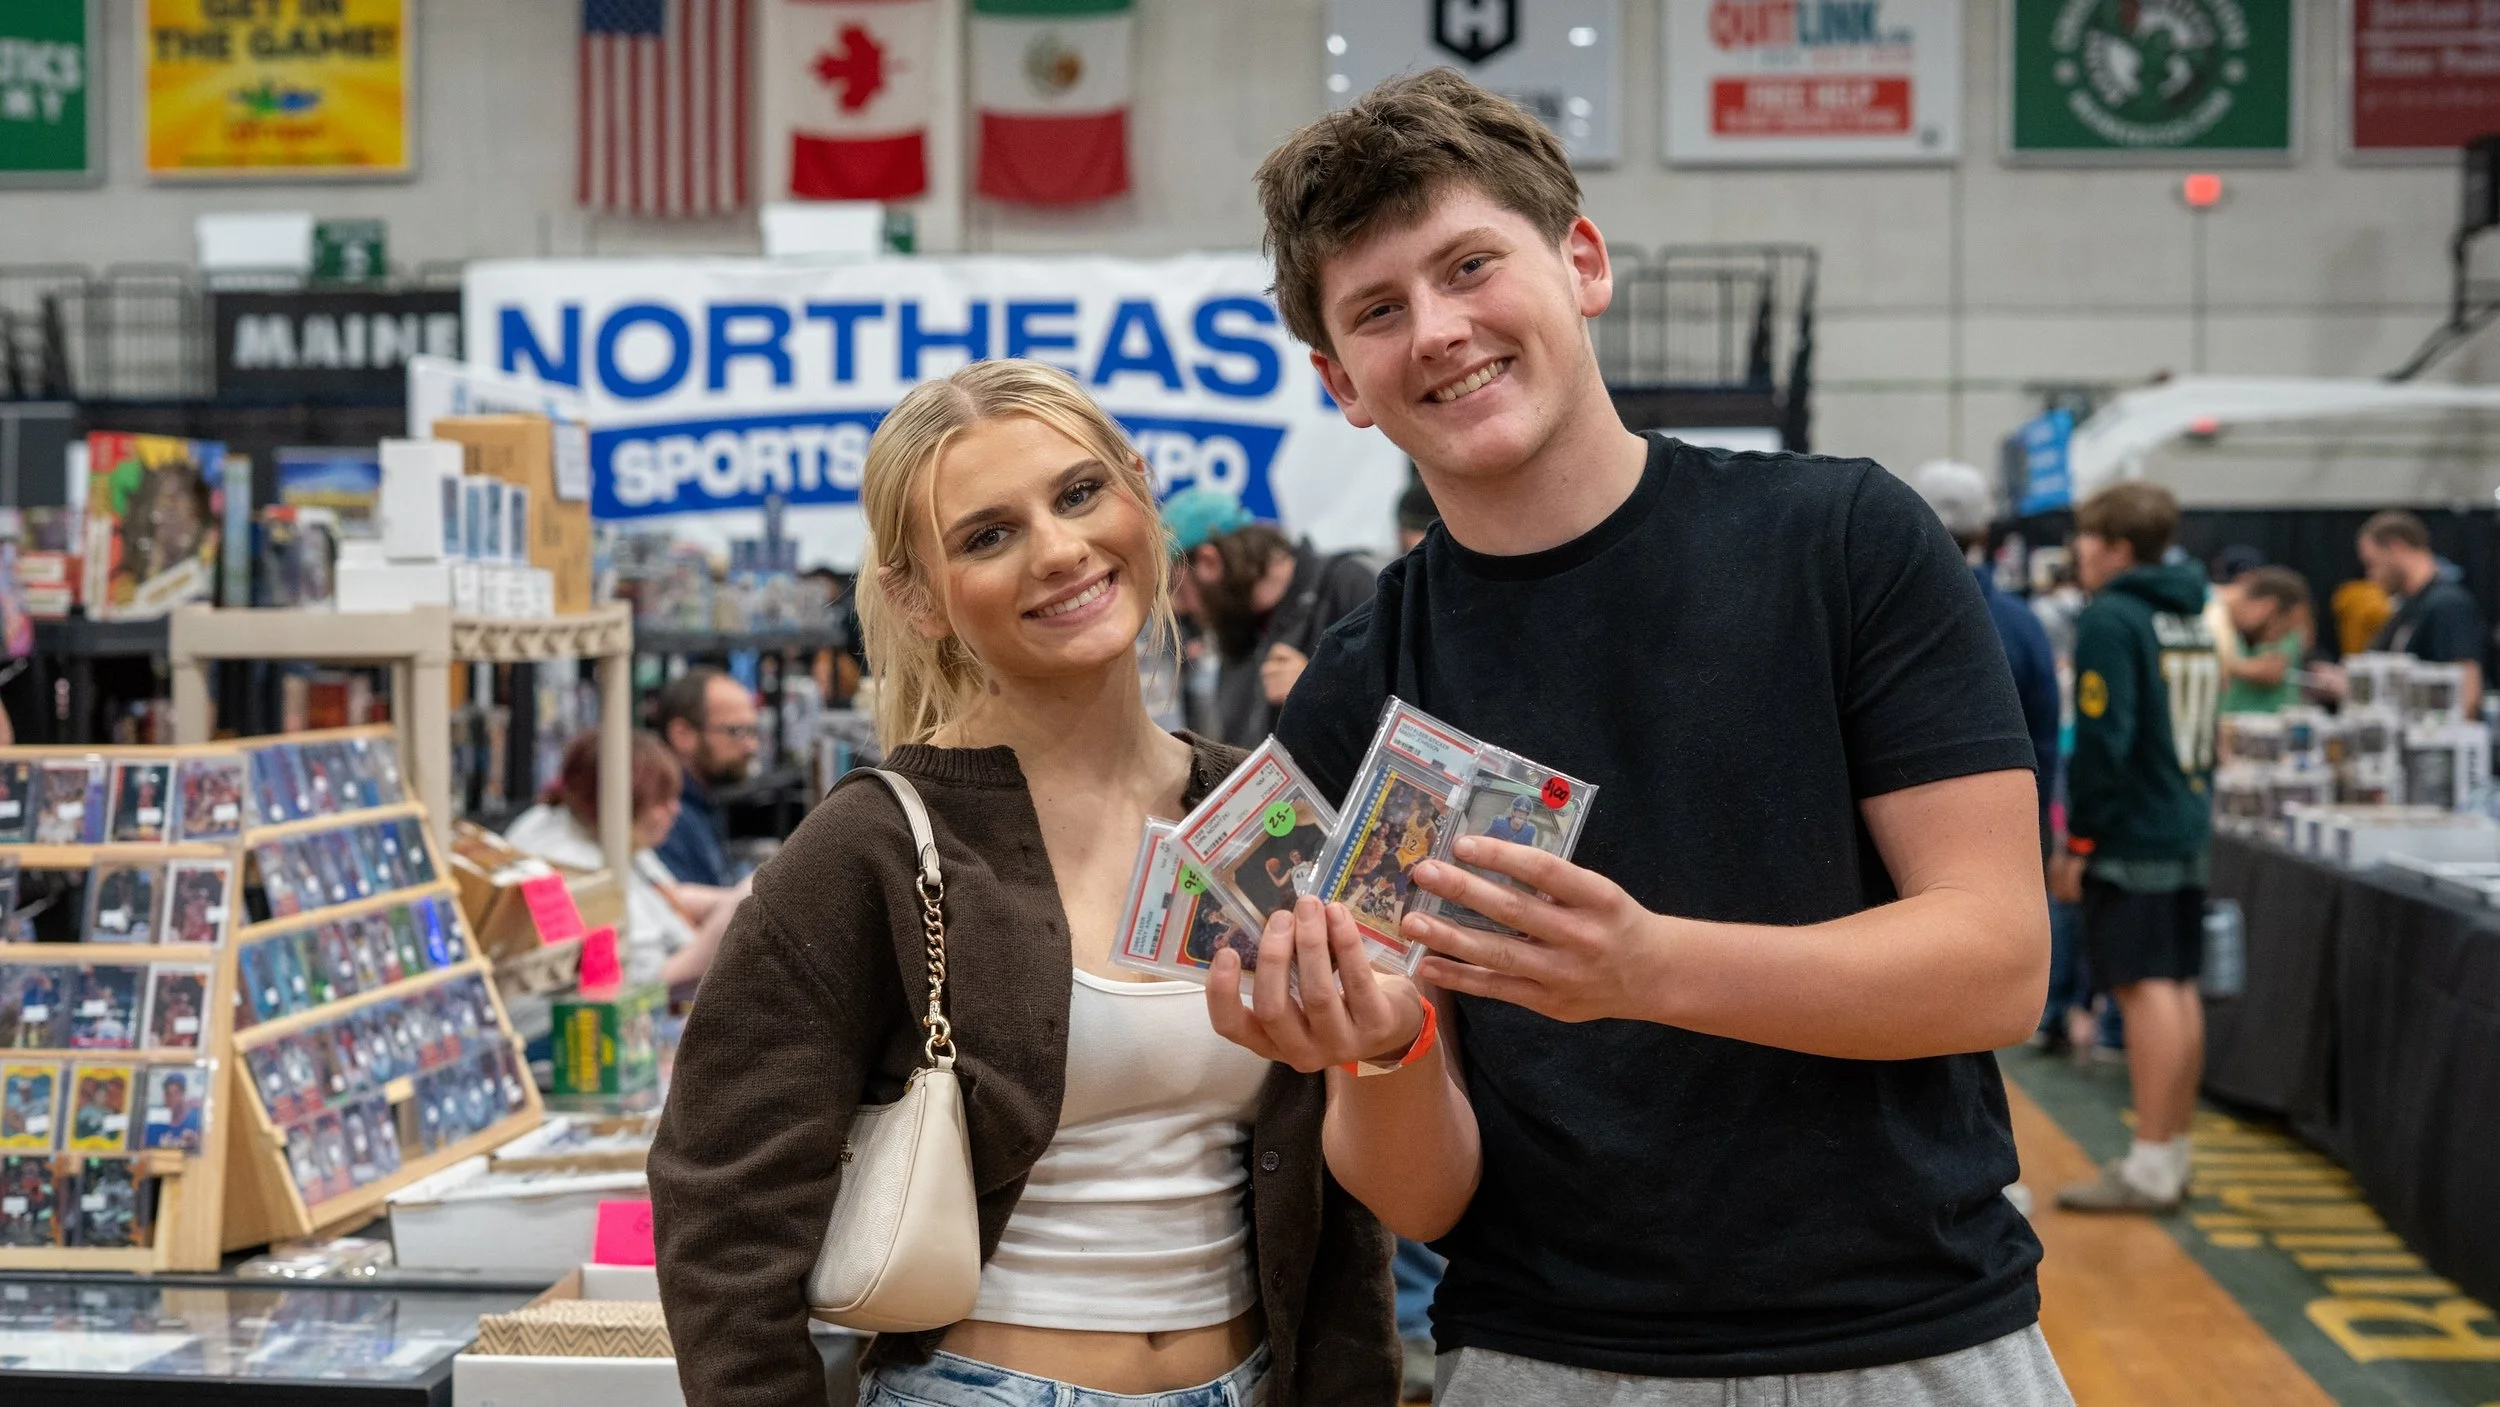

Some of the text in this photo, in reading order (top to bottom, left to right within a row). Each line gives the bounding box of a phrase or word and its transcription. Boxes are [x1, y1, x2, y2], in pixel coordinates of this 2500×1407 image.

[154, 28, 229, 60] THE
[233, 312, 460, 370] MAINE
[498, 297, 1340, 408] NORTHEAS
[610, 422, 872, 506] SPORTS
[1415, 736, 1440, 752] JOHNSON
